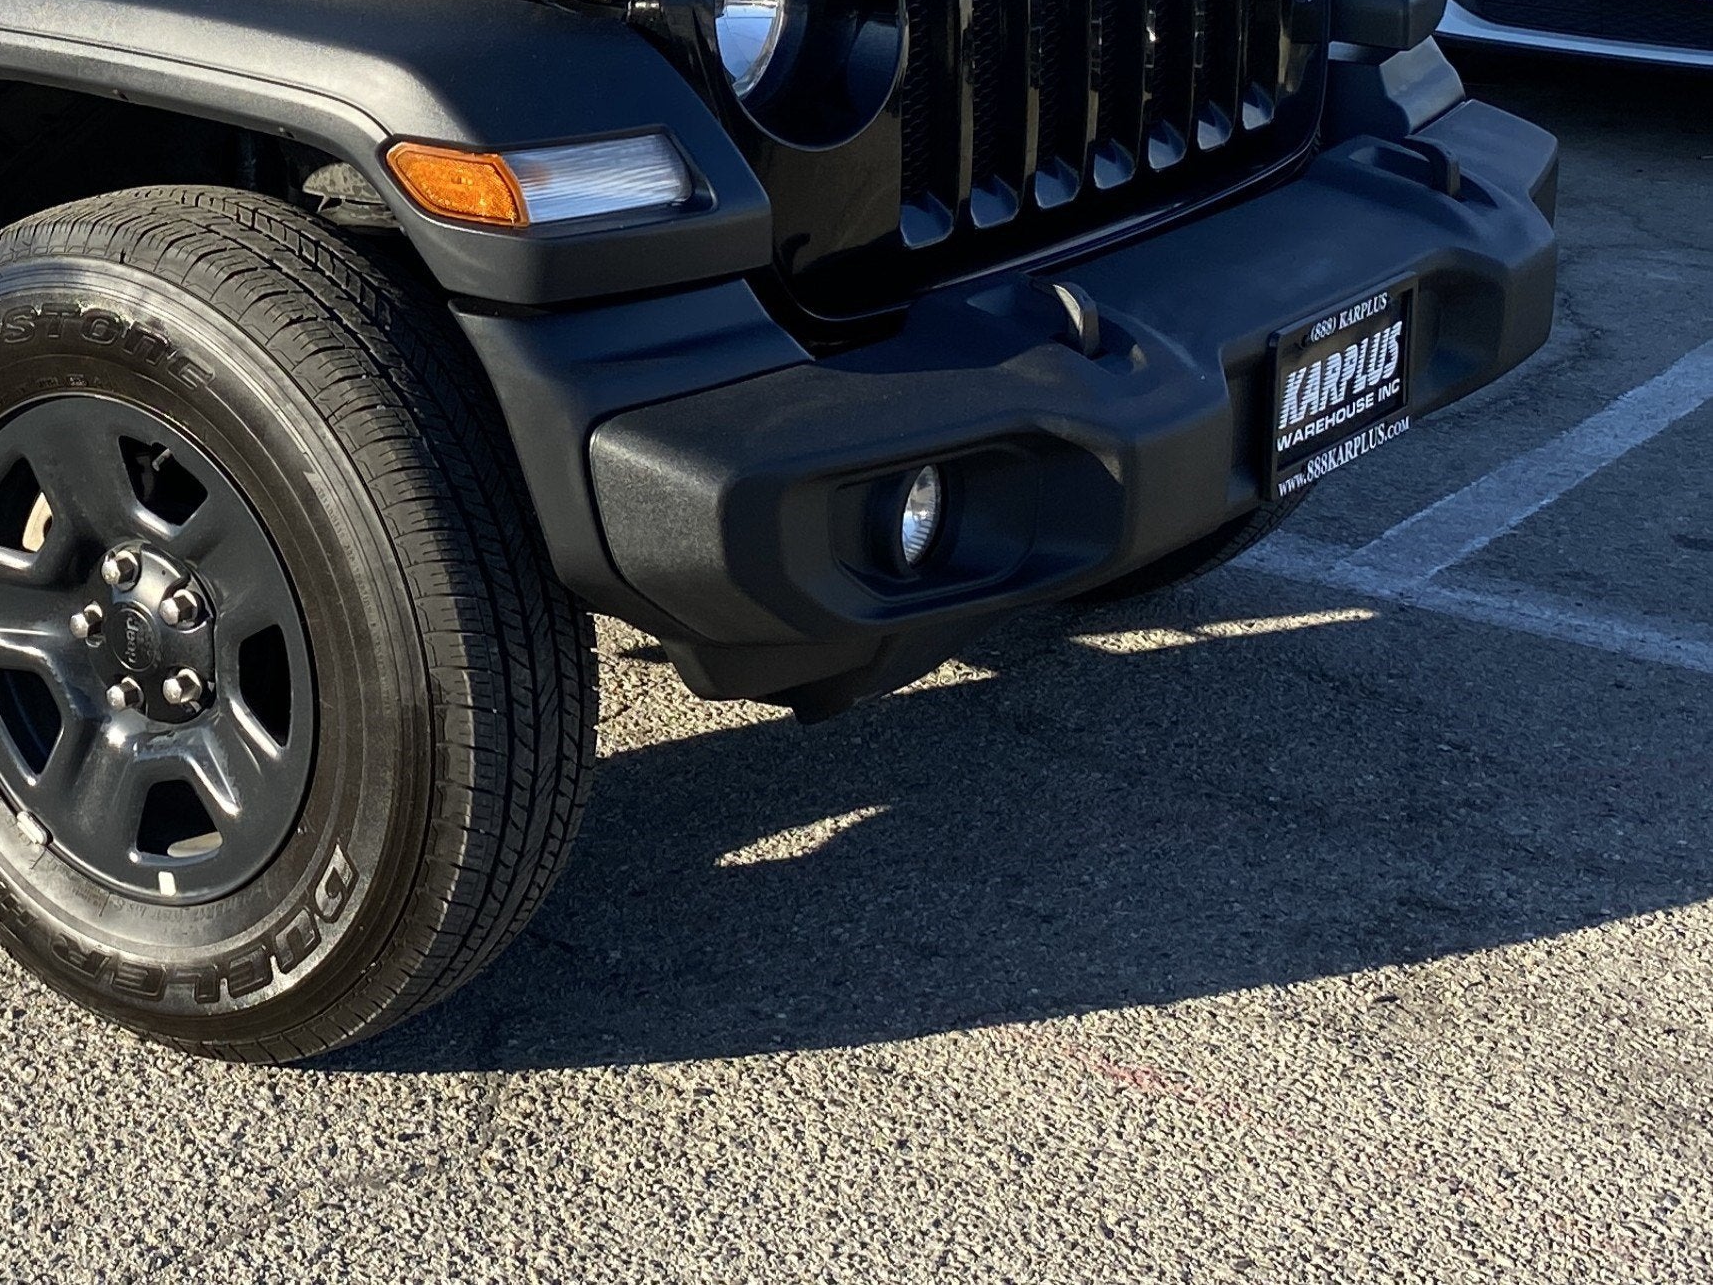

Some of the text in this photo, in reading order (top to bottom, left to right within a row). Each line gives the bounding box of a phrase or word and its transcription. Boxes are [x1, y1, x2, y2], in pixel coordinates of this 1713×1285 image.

[1310, 291, 1388, 342] (888) KARPLUS
[1276, 378, 1401, 452] WAREHOUSE INC
[1278, 321, 1402, 430] KARPLUS
[50, 842, 359, 1004] DUELER
